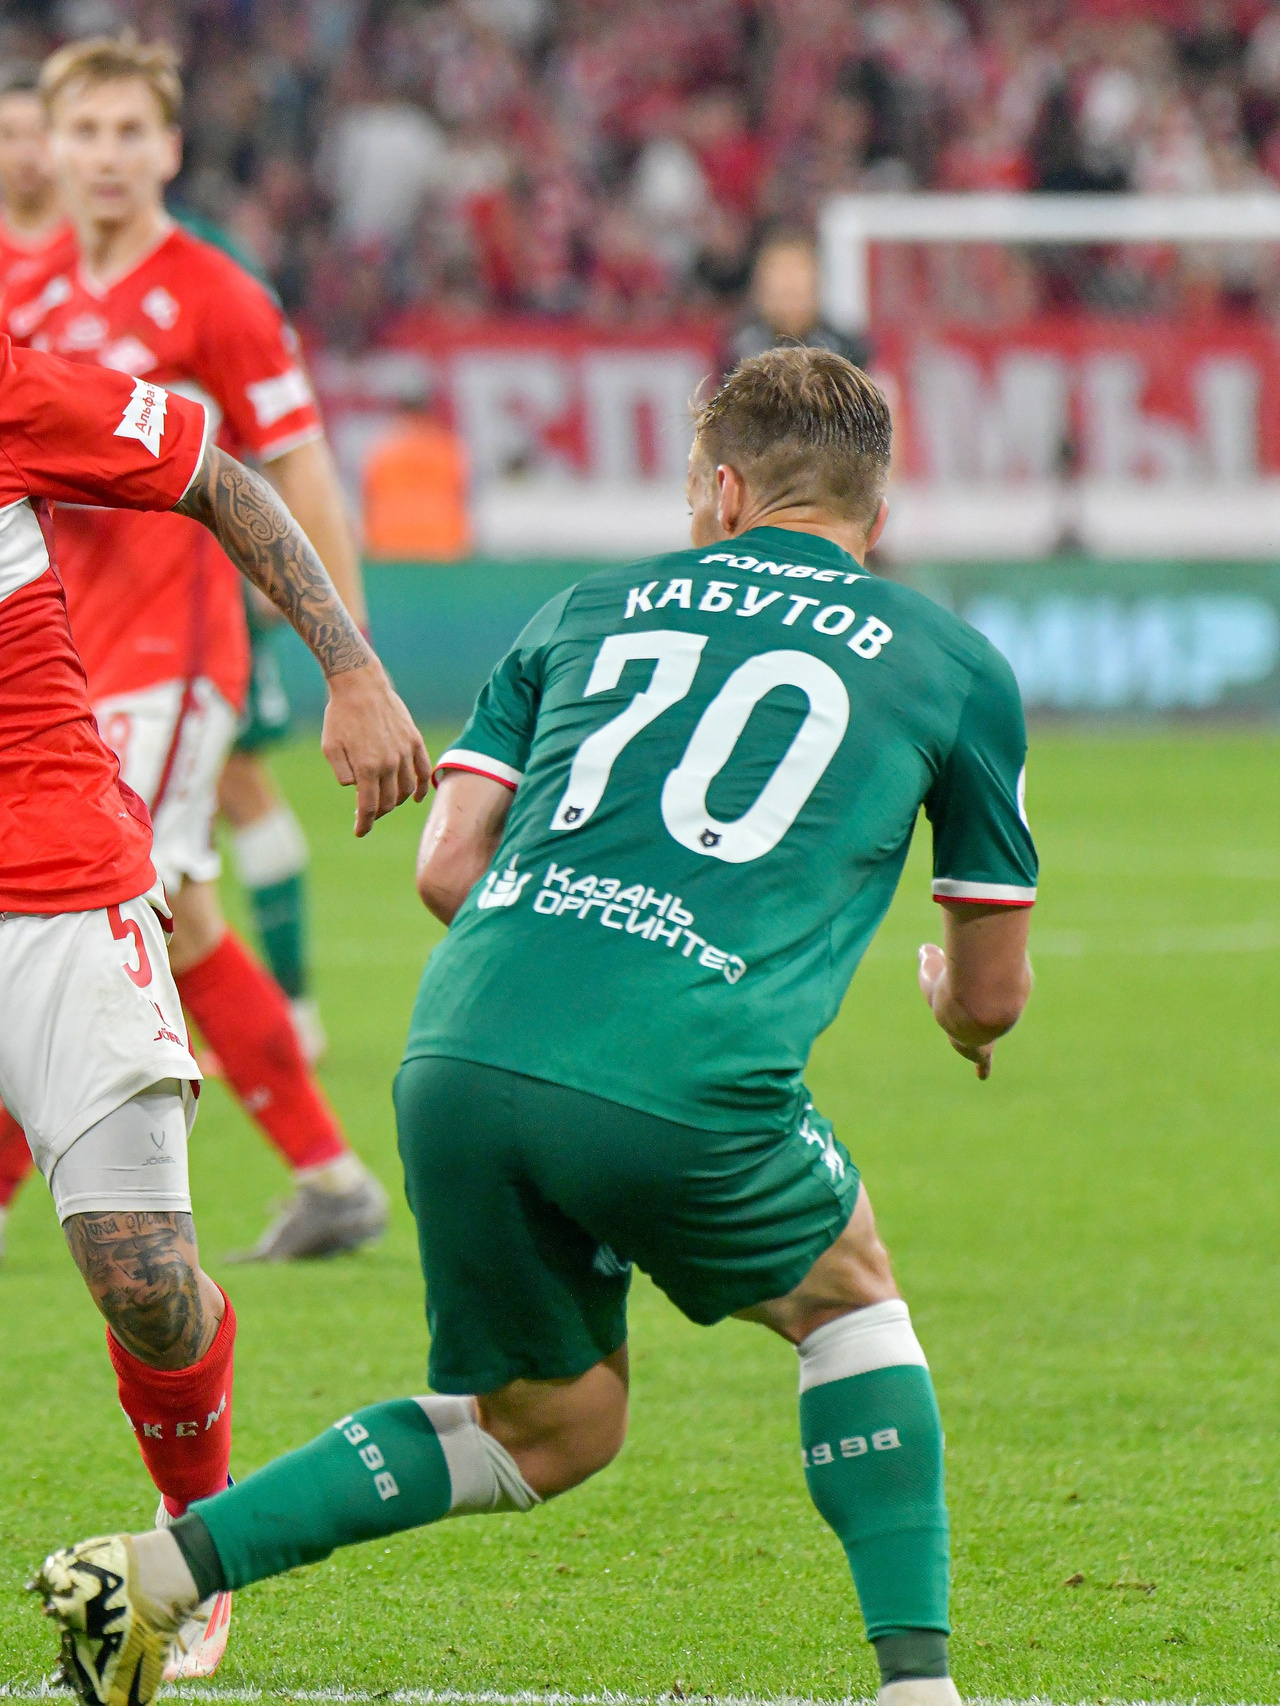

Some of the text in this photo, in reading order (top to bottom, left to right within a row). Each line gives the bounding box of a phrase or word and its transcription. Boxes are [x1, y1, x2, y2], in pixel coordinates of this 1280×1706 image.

[135, 389, 156, 433] Альфа
[699, 553, 871, 585] FONBET
[624, 578, 894, 659] КАБУТОВ
[550, 630, 850, 864] 70
[542, 862, 695, 927] КАЗАНЬ
[107, 904, 153, 989] 5
[533, 889, 748, 985] ОРГСИНТЕЗ
